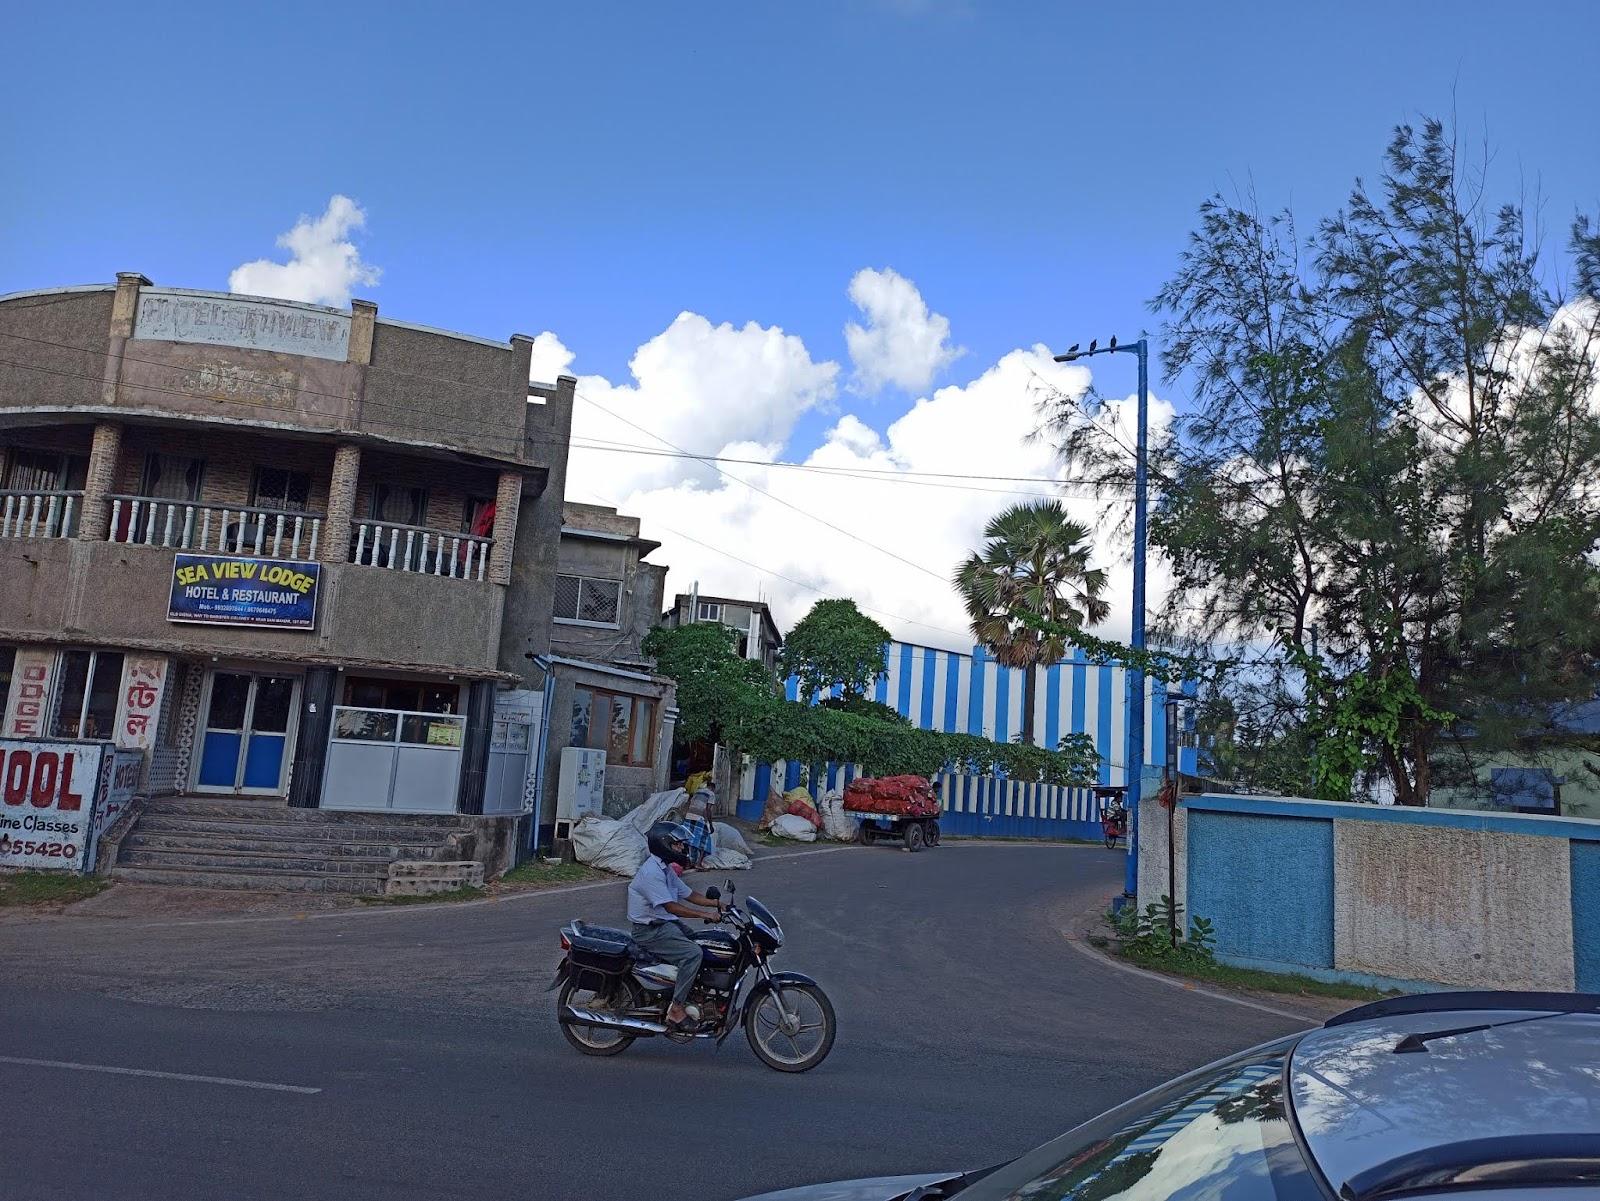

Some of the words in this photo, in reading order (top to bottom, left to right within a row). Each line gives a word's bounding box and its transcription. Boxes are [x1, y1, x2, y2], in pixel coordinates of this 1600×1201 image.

[176, 565, 209, 586] SEA
[211, 562, 258, 580] VIEW
[259, 565, 316, 594] LODGE
[185, 586, 220, 601] HOTEL
[222, 588, 229, 601] &
[231, 588, 300, 605] RESTAURANT
[14, 657, 47, 736] ODGE
[0, 750, 82, 811] OOL
[0, 814, 21, 830] ine
[23, 815, 79, 833] Classes
